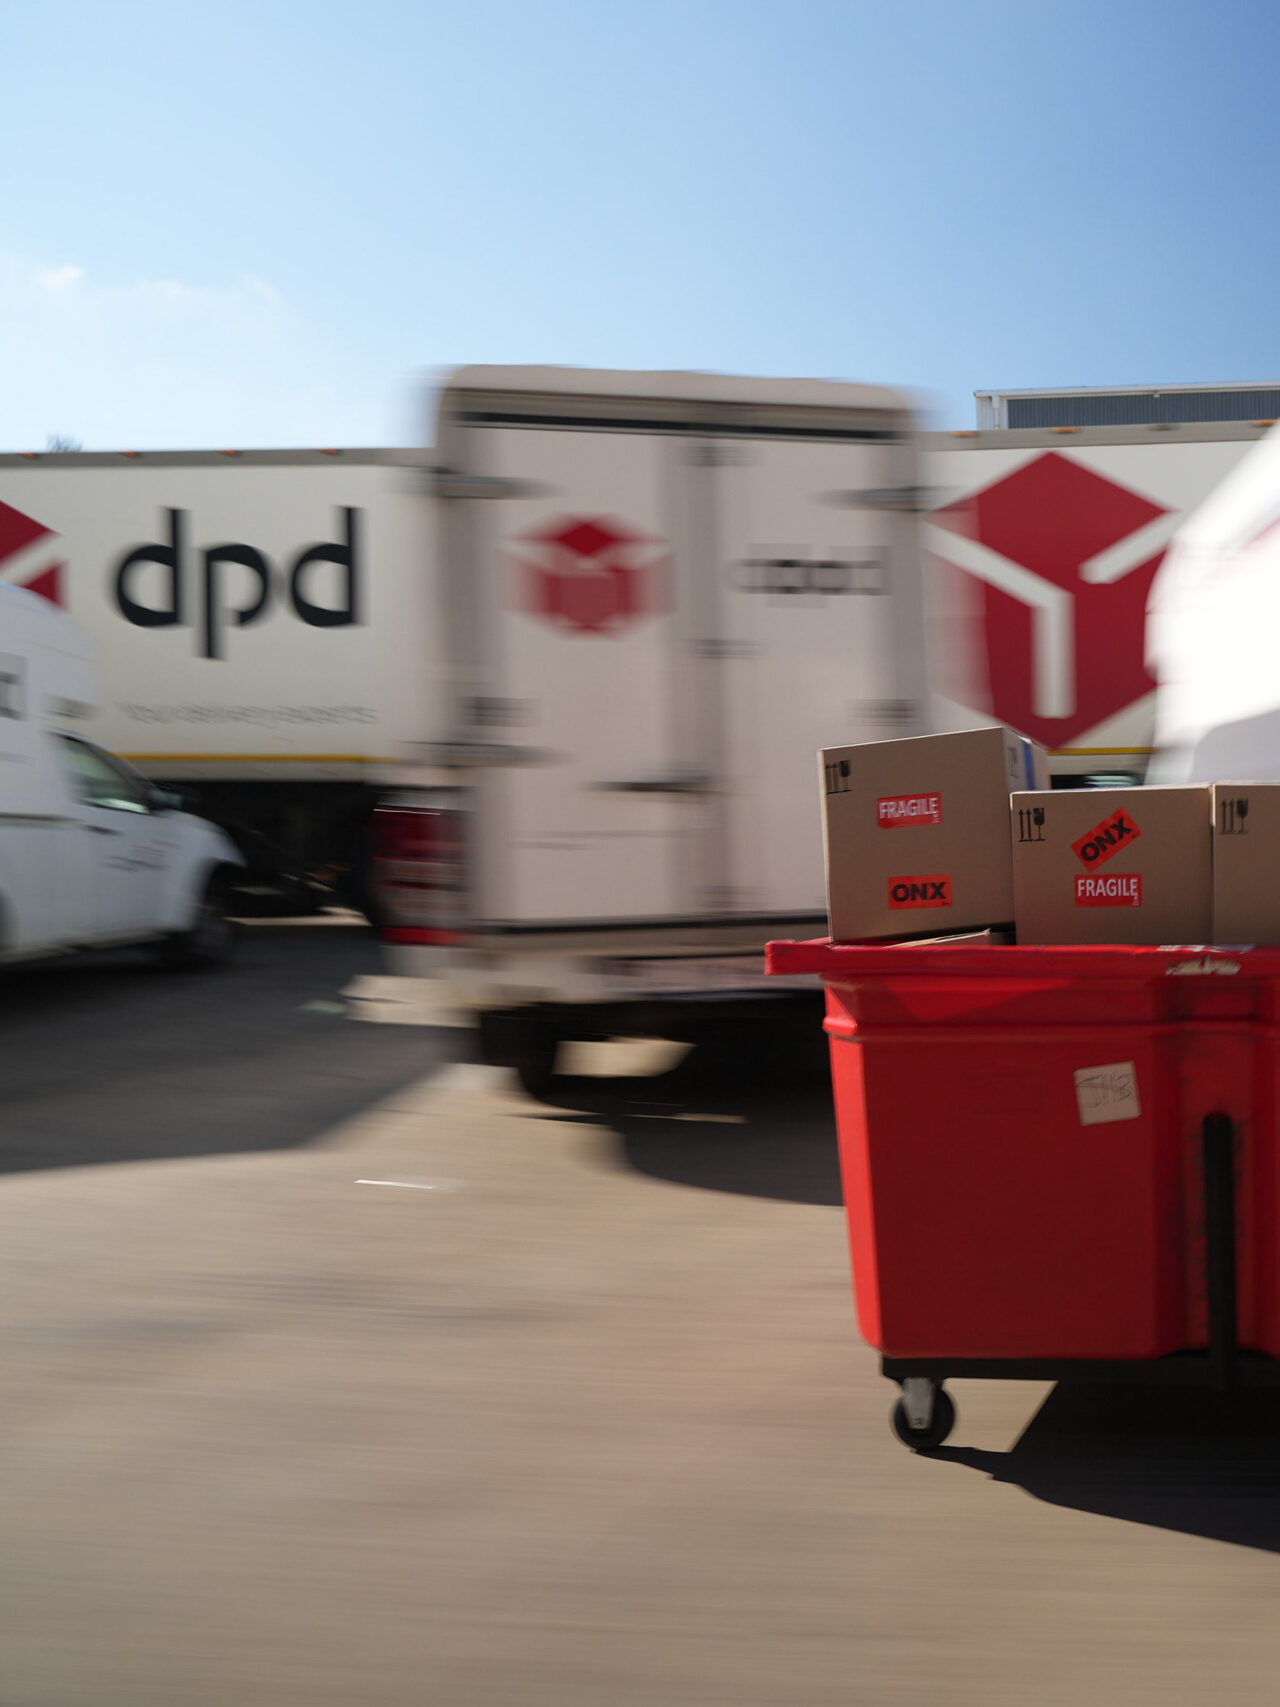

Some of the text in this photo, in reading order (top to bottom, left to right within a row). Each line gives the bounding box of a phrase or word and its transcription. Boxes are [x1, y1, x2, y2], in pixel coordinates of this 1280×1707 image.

[112, 506, 366, 661] dpd
[879, 797, 938, 819] FRAGILE
[1081, 816, 1133, 862] ONX
[891, 881, 946, 902] ONX
[1077, 878, 1139, 897] FRAGILE
